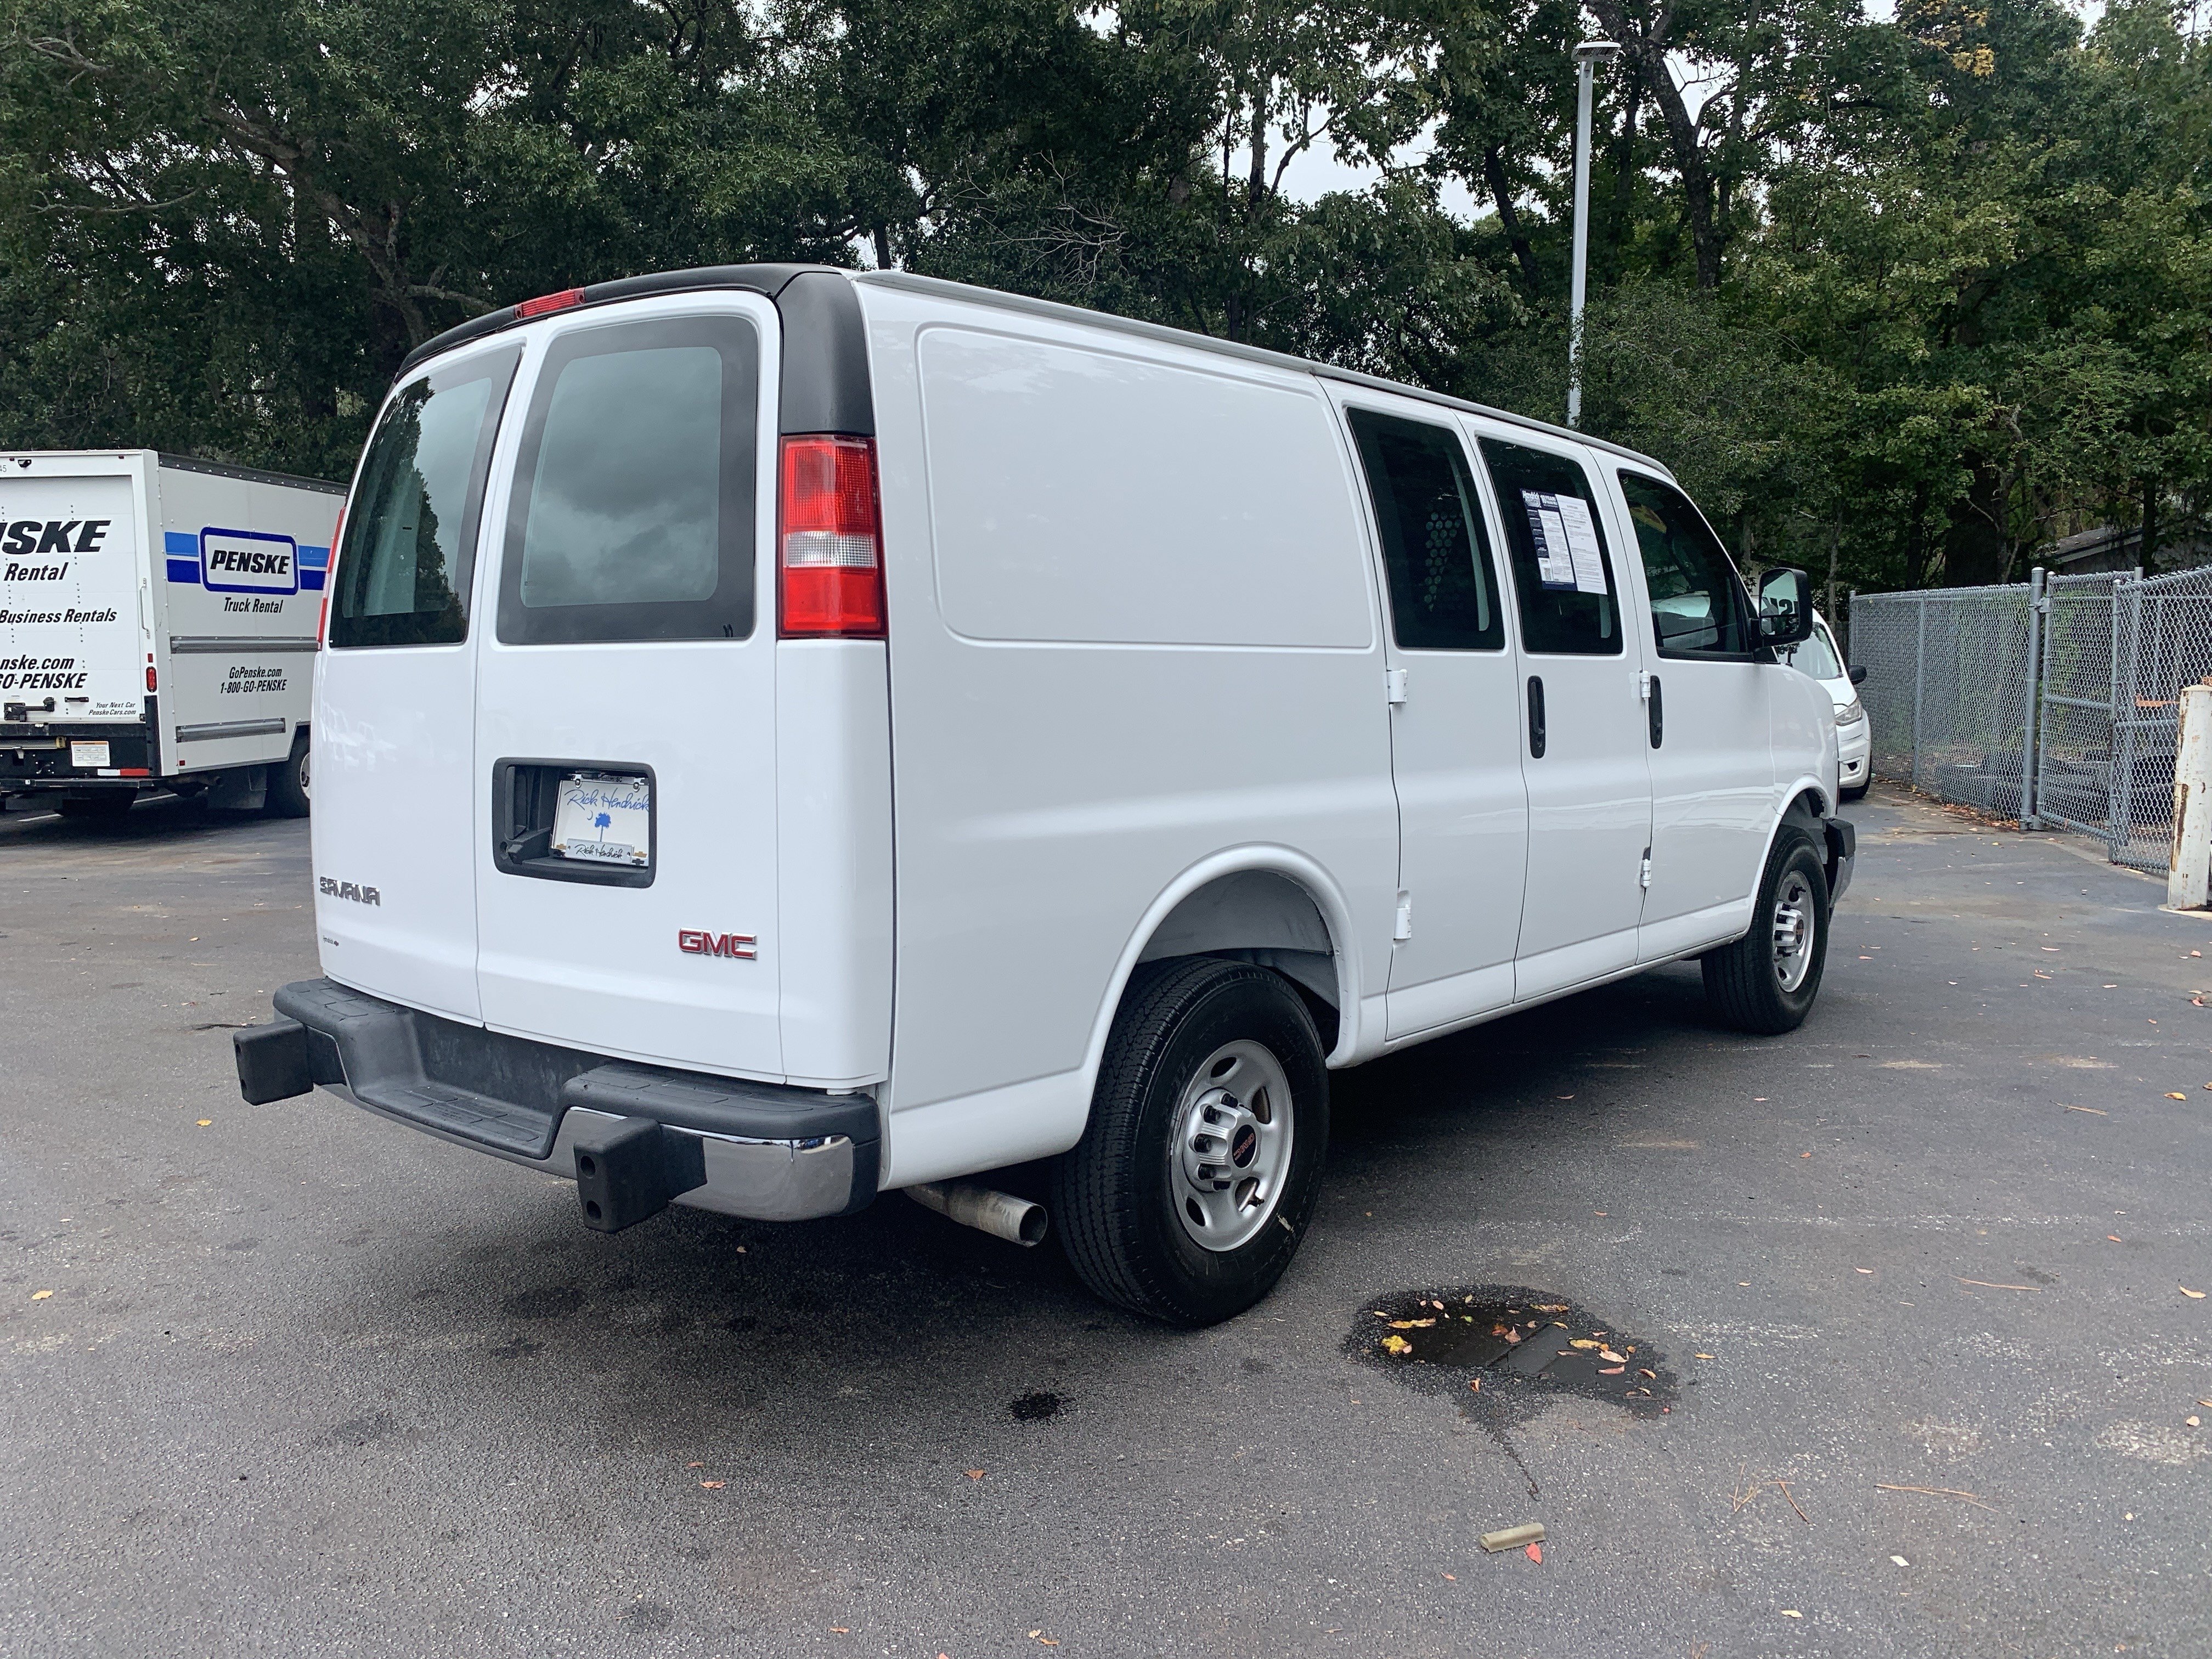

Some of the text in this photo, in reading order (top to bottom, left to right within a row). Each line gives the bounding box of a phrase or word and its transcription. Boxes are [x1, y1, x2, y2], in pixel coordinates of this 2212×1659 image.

[0, 520, 111, 555] SKE
[3, 562, 69, 582] Rental
[210, 550, 290, 574] PENSKE
[224, 597, 284, 613] Truck Rental
[0, 608, 117, 623] Business Rentals
[0, 654, 75, 670] nske.com
[229, 666, 283, 679] GoPenske.com
[221, 679, 287, 694] 1-800-GO-PENSKE
[564, 787, 649, 812] Rick Hendrick
[574, 844, 623, 860] Rick Hendrick
[320, 876, 381, 906] SAVANA
[679, 927, 757, 961] GMC
[1233, 1132, 1255, 1161] GMC
